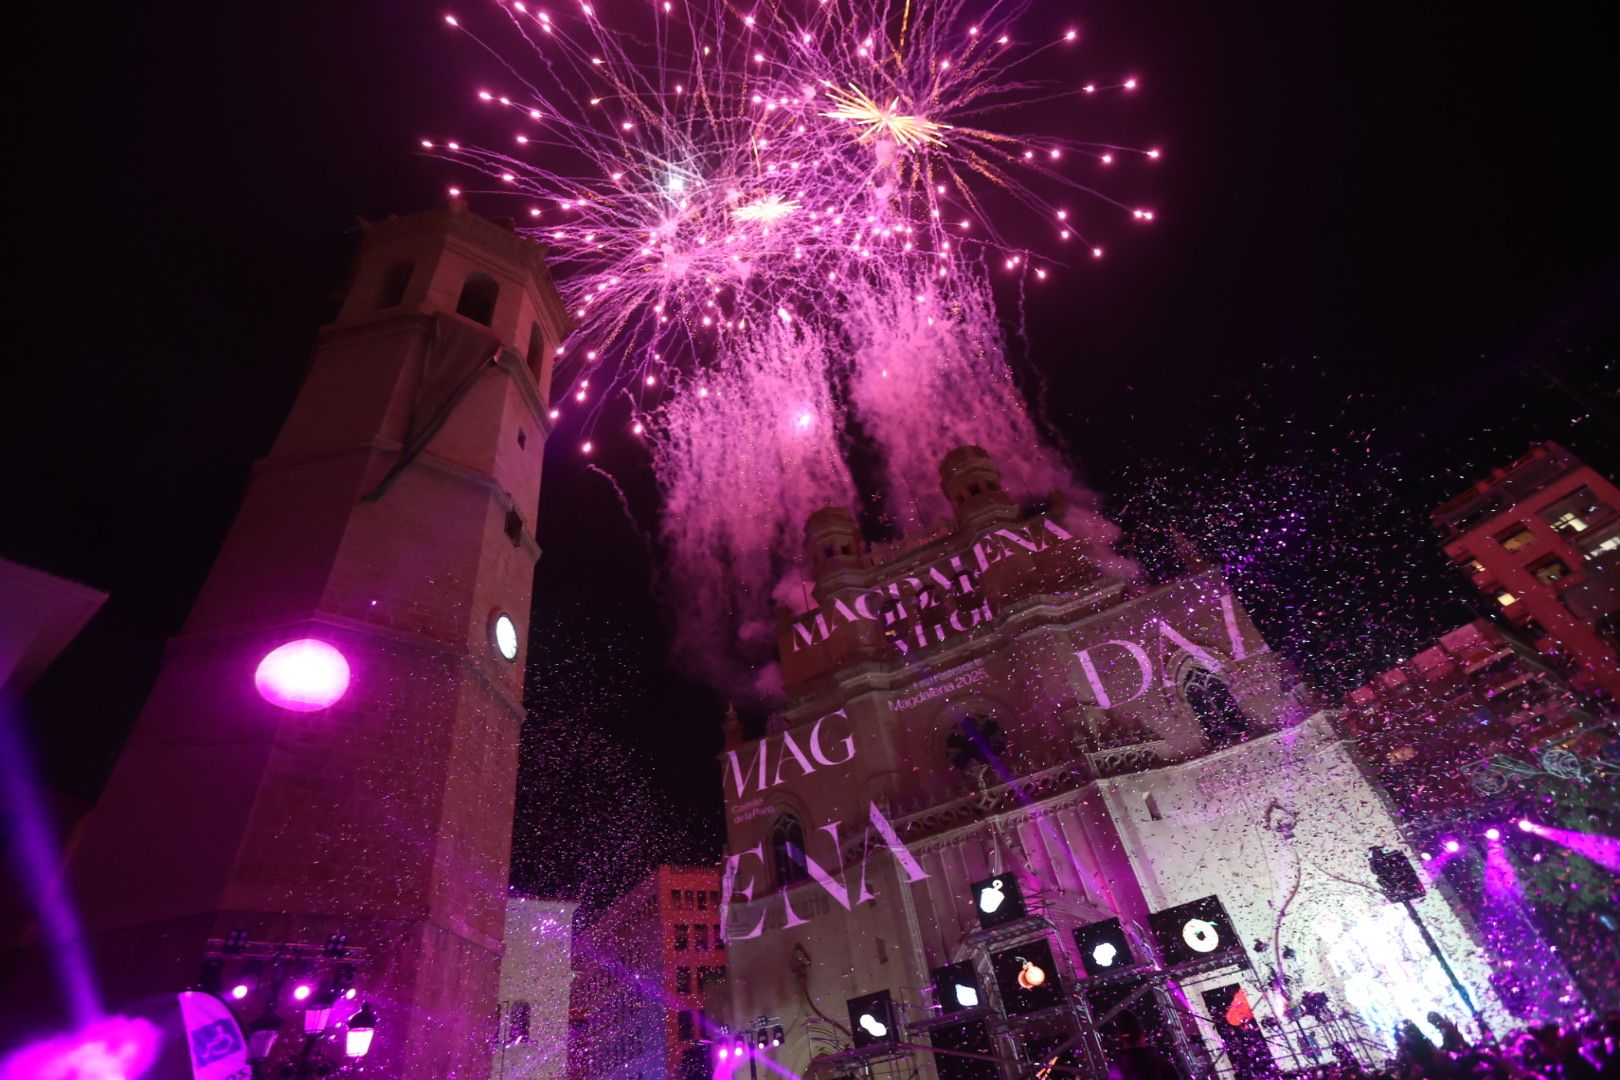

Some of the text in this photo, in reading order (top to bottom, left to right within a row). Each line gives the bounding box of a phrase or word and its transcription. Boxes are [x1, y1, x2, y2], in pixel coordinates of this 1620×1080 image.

[792, 518, 1072, 651] MAGDALENA
[722, 707, 857, 799] MAG
[719, 800, 932, 944] ENA
